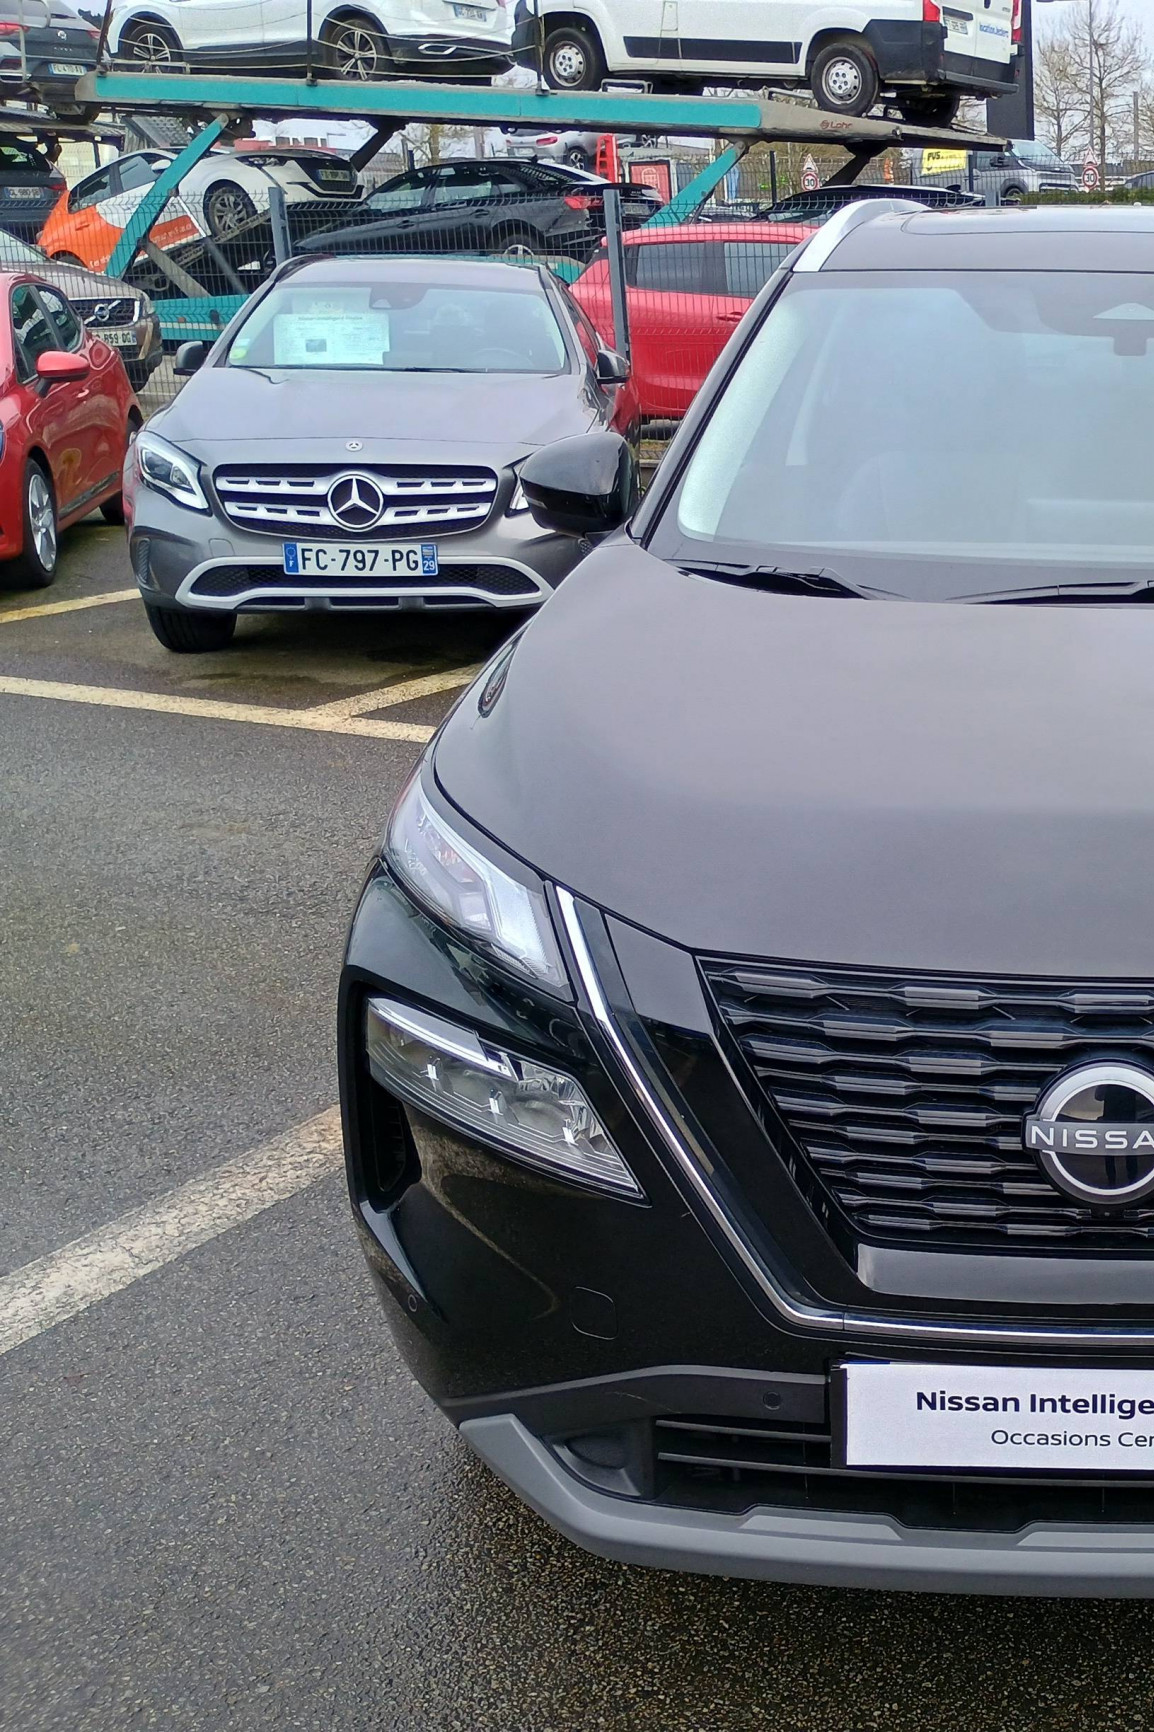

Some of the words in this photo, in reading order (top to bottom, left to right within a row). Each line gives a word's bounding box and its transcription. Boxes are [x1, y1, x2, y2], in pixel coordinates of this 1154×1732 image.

[1085, 173, 1095, 183] 30
[300, 547, 419, 572] FC-797-PG
[423, 560, 435, 571] 29
[916, 1390, 1021, 1413] Nissan
[990, 1429, 1111, 1447] Occasions
